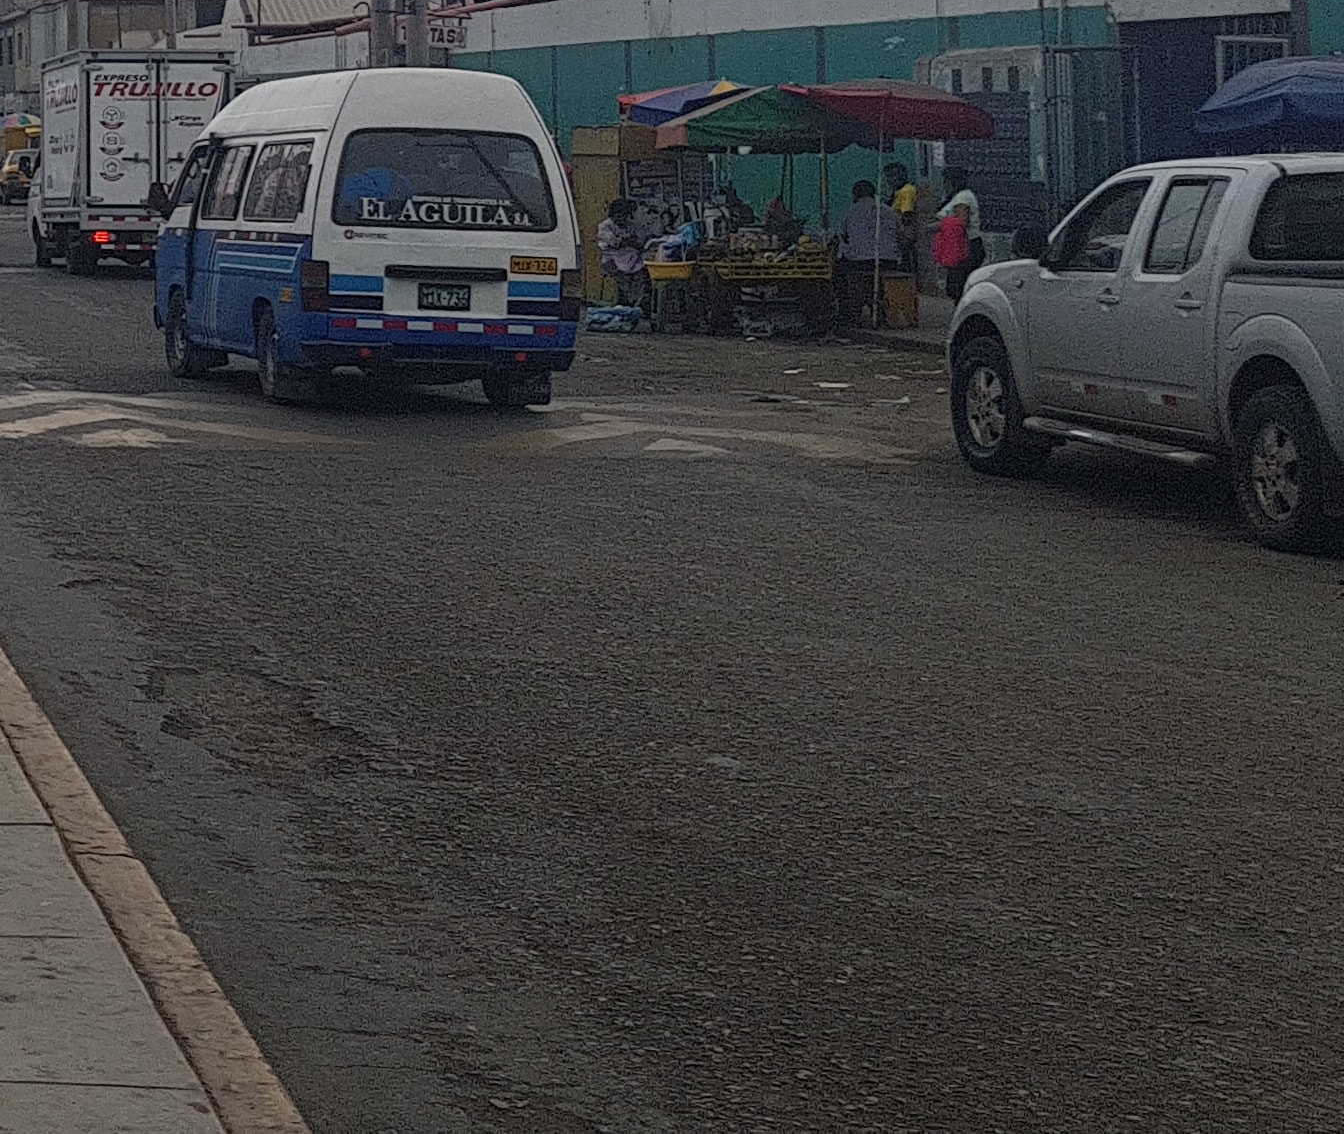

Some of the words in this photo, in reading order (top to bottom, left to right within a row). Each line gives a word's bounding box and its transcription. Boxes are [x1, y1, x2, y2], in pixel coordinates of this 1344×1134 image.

[95, 73, 150, 82] EXPRESO
[93, 82, 219, 97] TRUJILLO
[359, 197, 392, 221] EL
[398, 199, 511, 227] AGUILA
